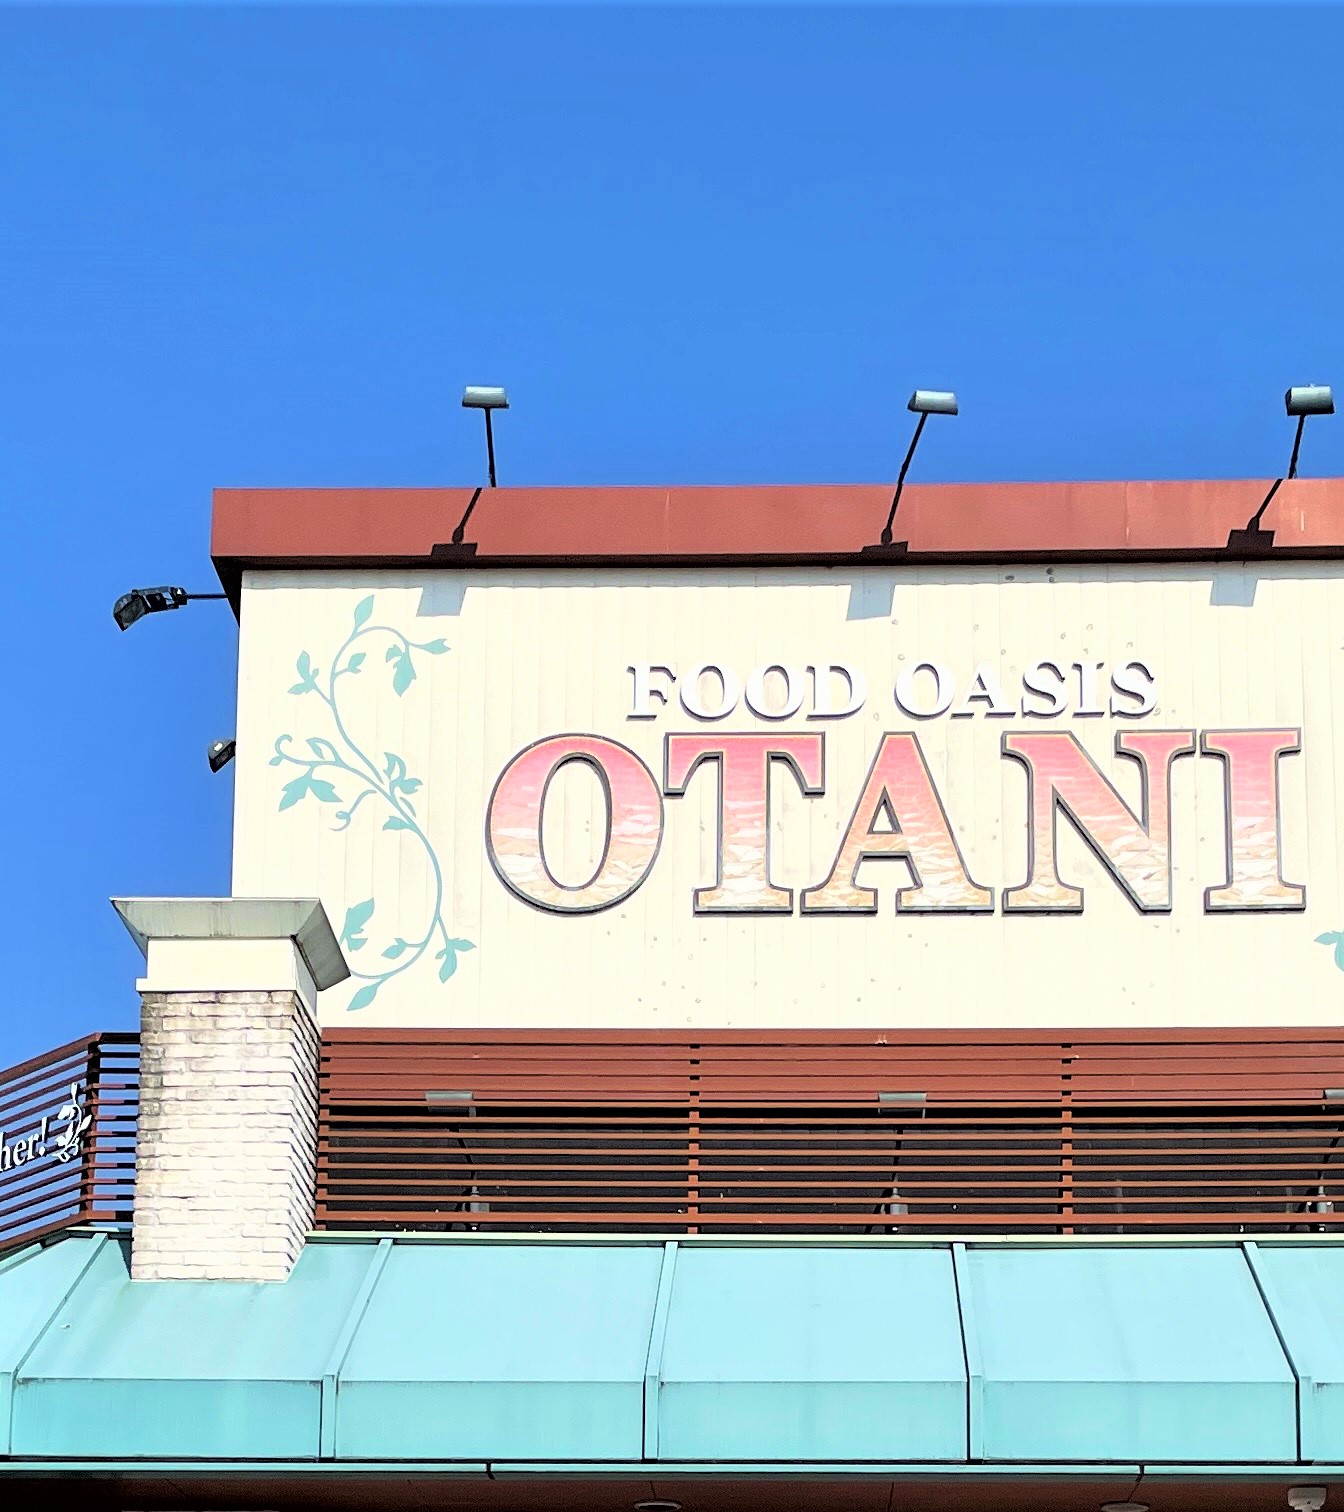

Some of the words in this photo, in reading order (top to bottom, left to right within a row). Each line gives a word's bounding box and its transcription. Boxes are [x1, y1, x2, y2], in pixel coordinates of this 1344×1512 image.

[625, 663, 868, 721] FOOD
[893, 661, 1160, 720] OASIS
[484, 727, 1307, 917] OTANI
